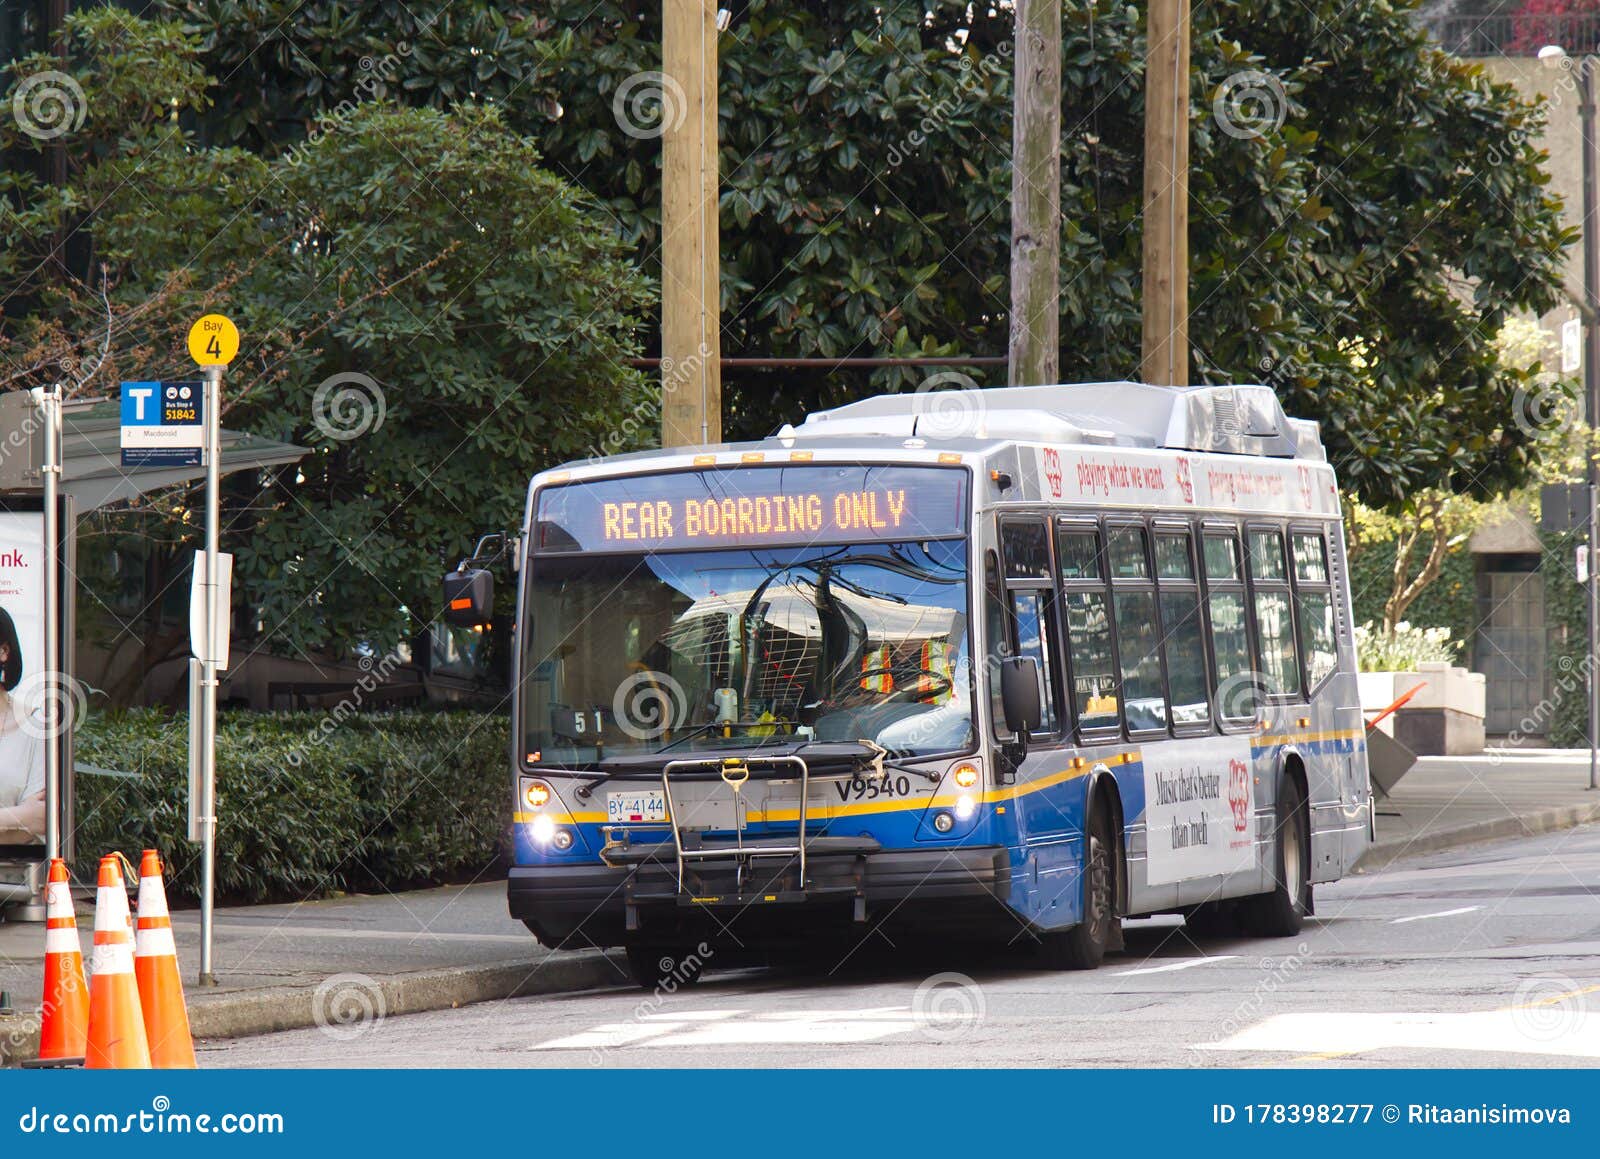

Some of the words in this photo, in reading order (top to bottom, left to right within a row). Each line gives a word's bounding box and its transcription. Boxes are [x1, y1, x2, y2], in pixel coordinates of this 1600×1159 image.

[203, 320, 223, 333] Bay
[206, 335, 221, 359] 4
[128, 388, 153, 420] T
[166, 409, 196, 420] 51842
[143, 429, 178, 438] Macdonald
[1077, 456, 1109, 496] playing
[1108, 459, 1130, 489] what
[1129, 465, 1143, 489] we
[1142, 466, 1165, 490] want
[604, 501, 673, 539] REAR
[686, 495, 822, 536] BOARDING
[834, 488, 905, 529] ONLY
[834, 773, 910, 802] V9540
[1155, 771, 1178, 806] Music
[1197, 765, 1220, 800] better
[1172, 815, 1188, 850] than
